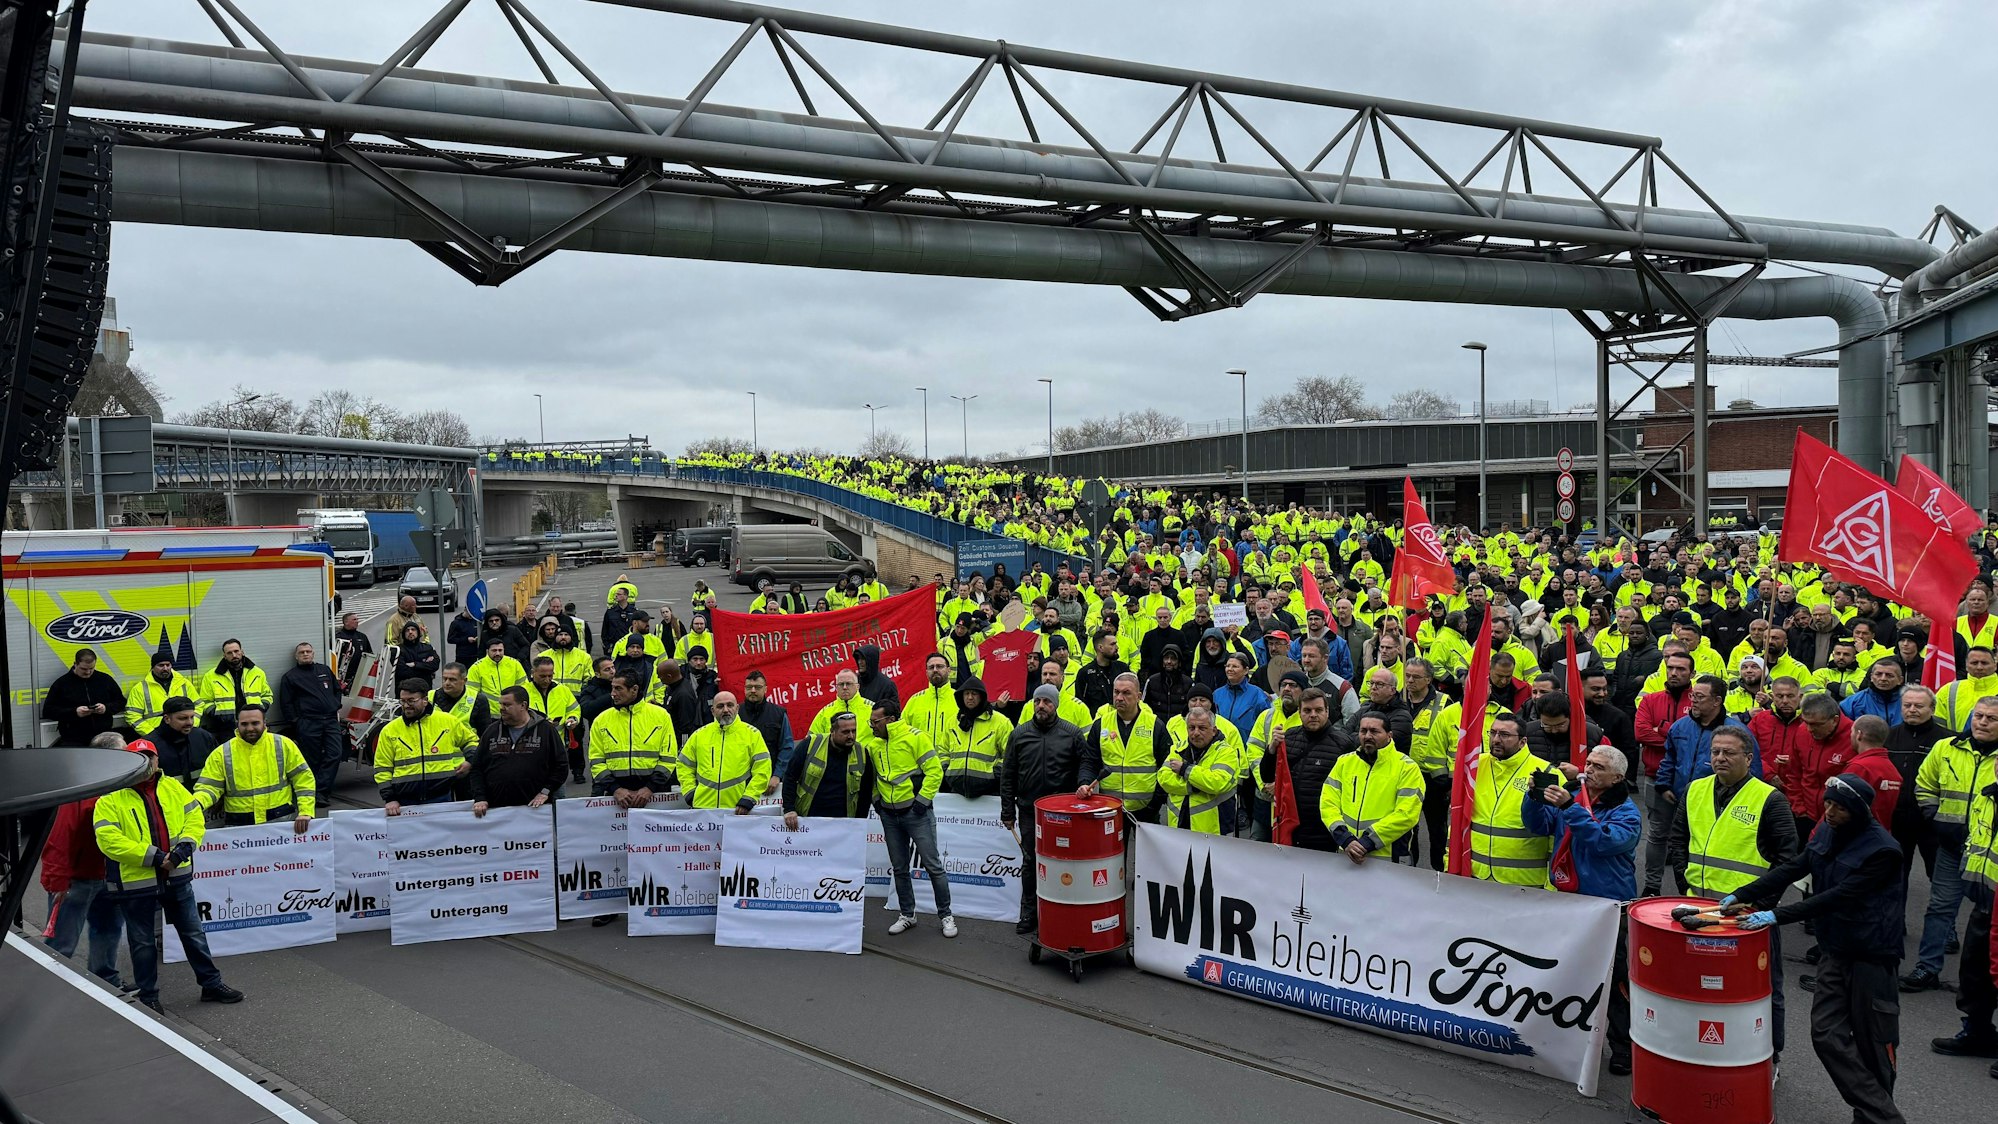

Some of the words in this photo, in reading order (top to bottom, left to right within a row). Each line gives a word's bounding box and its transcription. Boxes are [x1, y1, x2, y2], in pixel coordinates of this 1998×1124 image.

[67, 615, 129, 639] Ford
[737, 629, 792, 655] KAMPF
[801, 627, 827, 648] UM
[806, 679, 823, 697] ist
[645, 822, 692, 832] Schmiede
[695, 822, 705, 831] &
[937, 817, 960, 825] miede
[961, 816, 975, 825] und
[199, 841, 228, 853] ohne
[231, 835, 290, 850] Schmiede
[293, 833, 307, 844] ist
[311, 831, 331, 843] wie
[394, 844, 487, 861] Wassenberg
[504, 840, 547, 851] Unser
[600, 843, 628, 853] Druck
[628, 843, 663, 854] Kampf
[665, 844, 681, 852] um
[683, 843, 711, 854] jeden
[784, 836, 792, 845] &
[759, 847, 823, 857] Druckgusswerk
[193, 868, 237, 880] ommer
[241, 862, 270, 875] ohne
[273, 858, 314, 872] Sonne!
[559, 858, 603, 892] WIR
[684, 862, 711, 871] Halle
[395, 874, 475, 891] Untergang
[480, 873, 498, 884] ist
[503, 869, 539, 881] DEIN
[628, 872, 670, 906] WIR
[720, 861, 759, 897] WIR
[764, 866, 809, 900] bleiben
[814, 878, 865, 903] Ford
[218, 887, 272, 919] bleiben
[277, 888, 335, 912] Ford
[335, 887, 376, 913] WIR
[430, 904, 508, 919] Untergang
[1146, 844, 1257, 961] WIR
[1272, 873, 1412, 997] bleiben
[1428, 936, 1604, 1032] Ford
[1227, 970, 1305, 1004] GEMEINSAM
[1310, 990, 1428, 1033] WEITERKÄMPFEN
[1433, 1020, 1464, 1042] FÜR
[1469, 1027, 1512, 1050] KÖLN
